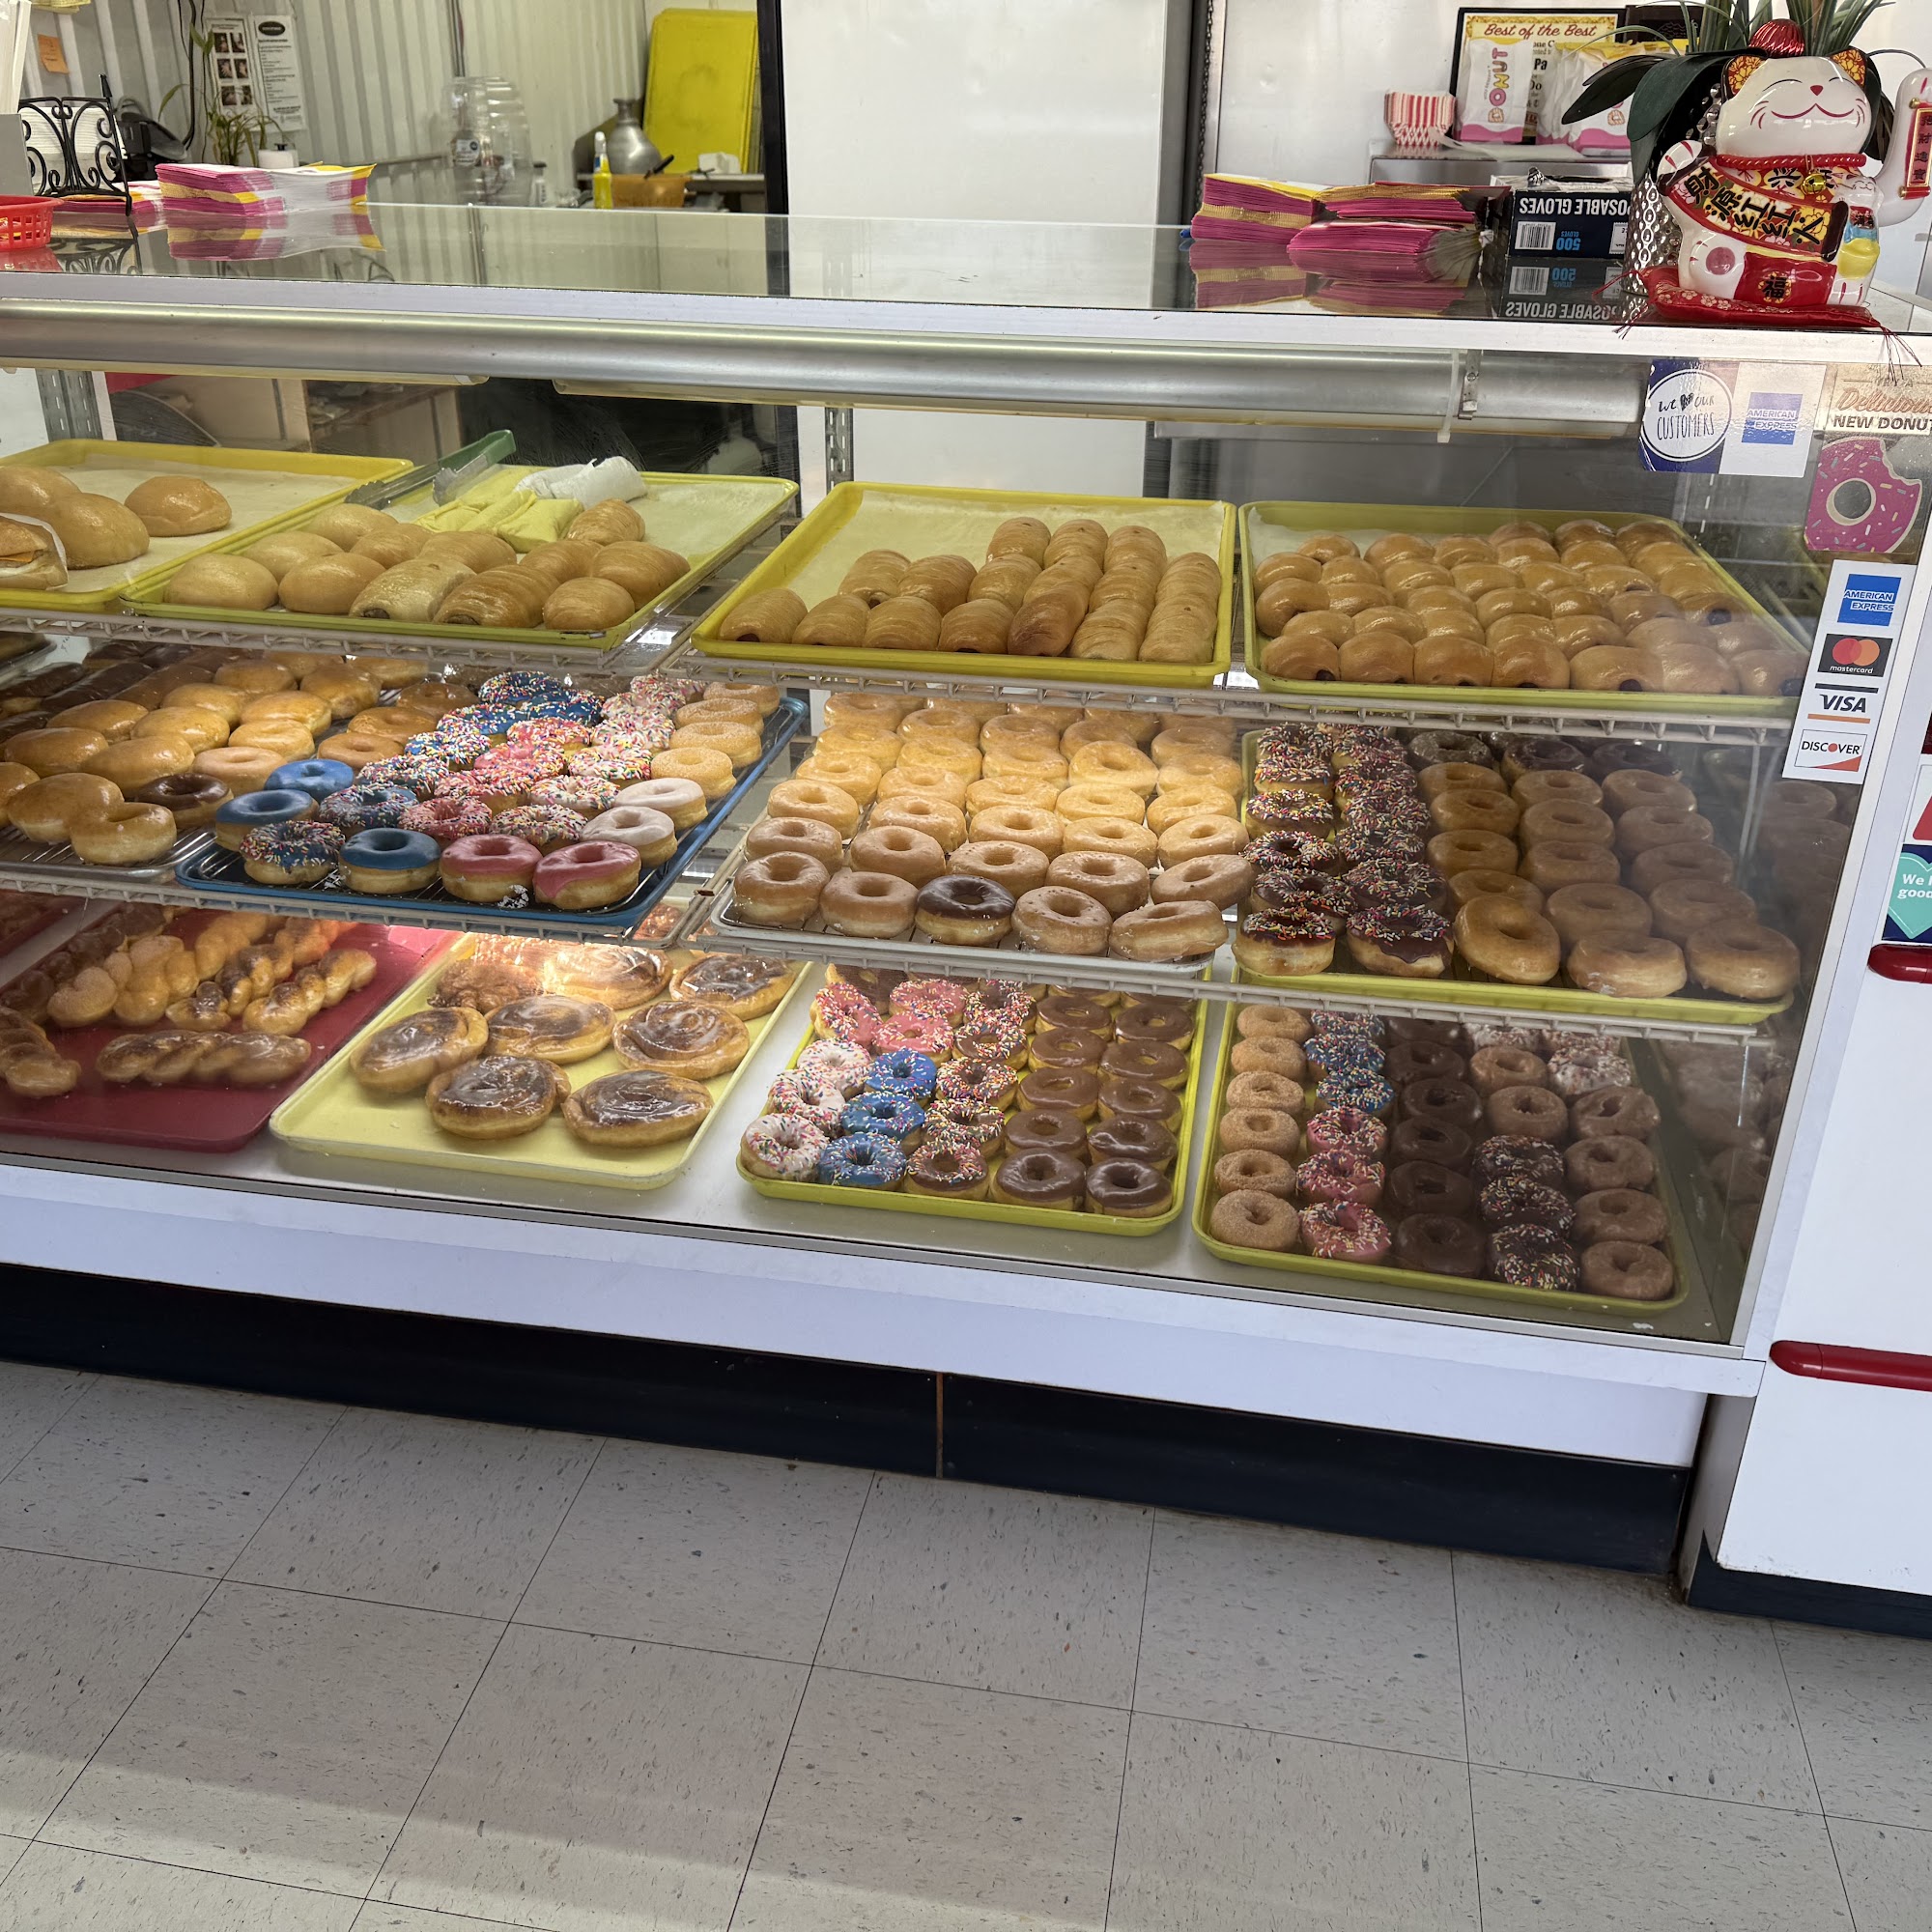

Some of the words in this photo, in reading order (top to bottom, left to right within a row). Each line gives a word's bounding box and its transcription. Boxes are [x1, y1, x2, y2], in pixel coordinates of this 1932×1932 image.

[1484, 24, 1517, 37] Best
[1519, 24, 1536, 40] of
[1537, 23, 1561, 37] the
[1564, 24, 1597, 37] Best
[1488, 47, 1510, 124] DONUT
[1519, 197, 1573, 215] GLOVES
[1556, 238, 1581, 251] 500
[1747, 410, 1796, 419] AMERICAN
[1657, 412, 1715, 440] CUSTOMERS
[1754, 421, 1798, 430] EXPRESS
[1833, 415, 1874, 429] NEW
[1844, 590, 1893, 602] AMERICAN
[1851, 602, 1894, 611] EXPRESS
[1830, 665, 1874, 674] mastercard
[1819, 694, 1866, 713] VISA
[1801, 741, 1861, 754] DISCOVER
[1902, 873, 1925, 886] We
